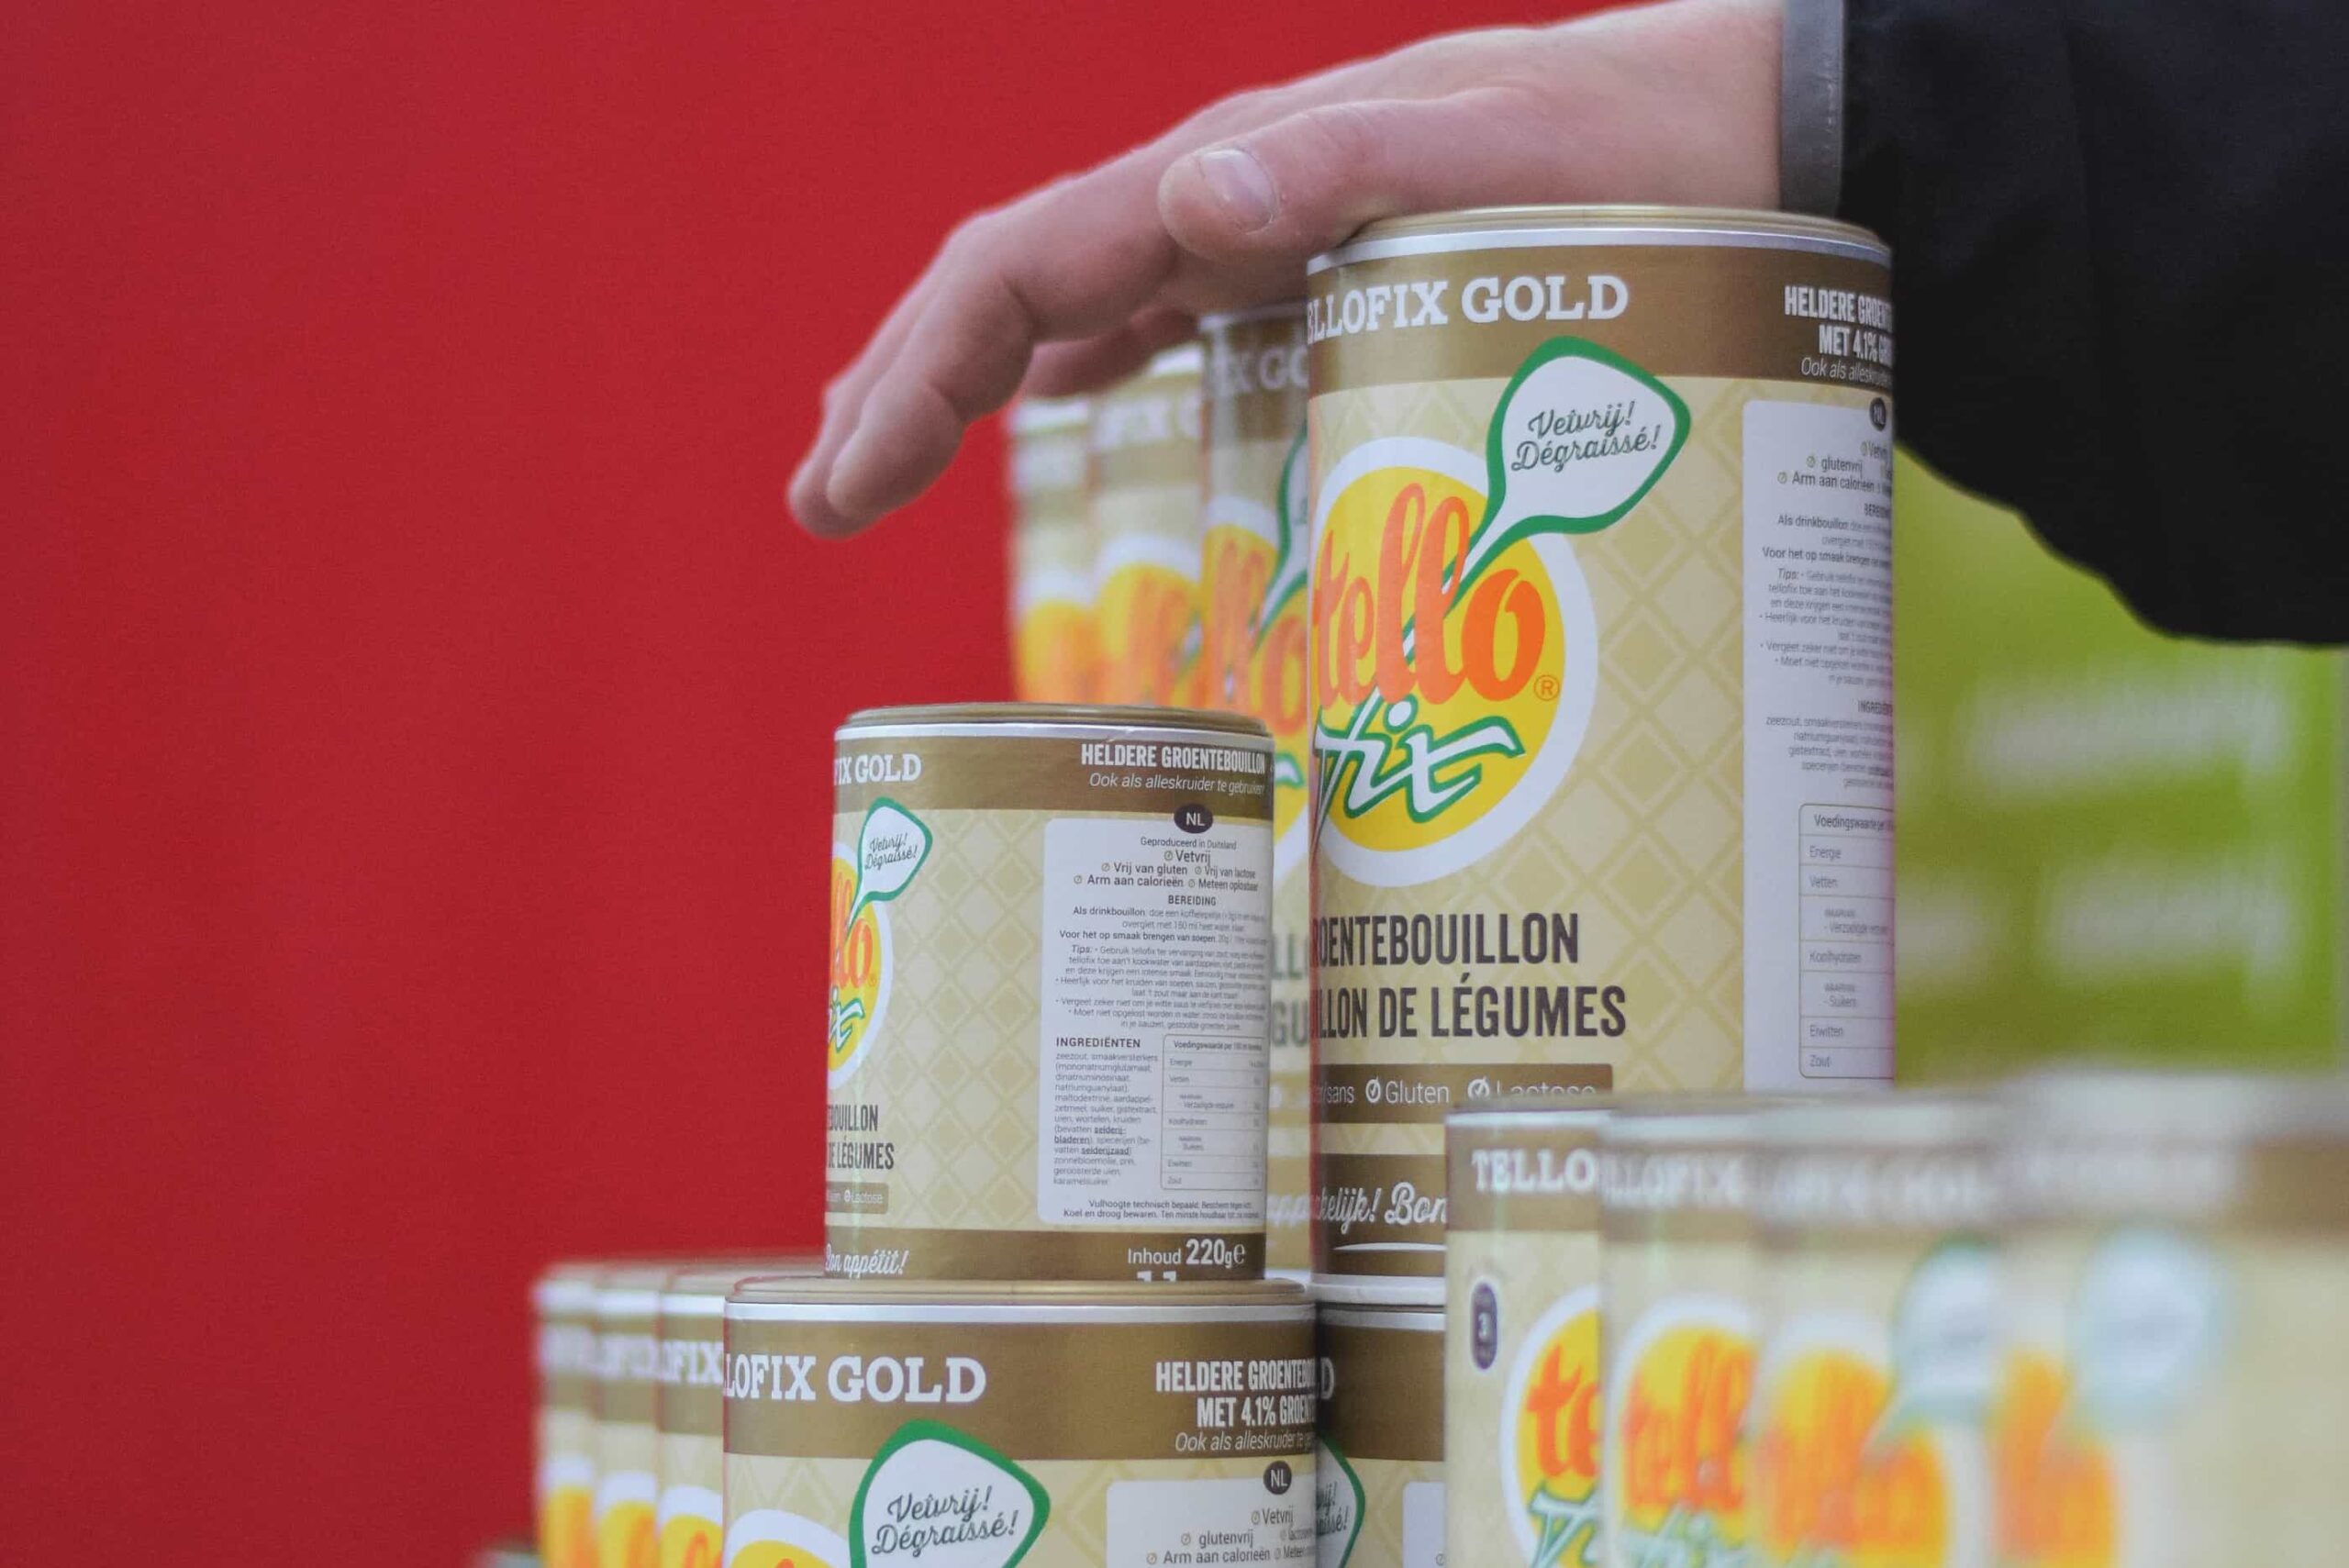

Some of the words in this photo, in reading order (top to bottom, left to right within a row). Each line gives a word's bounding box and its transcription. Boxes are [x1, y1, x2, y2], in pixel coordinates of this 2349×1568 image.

[1462, 274, 1630, 323] GOLD
[1784, 285, 1855, 323] HELDERE
[1819, 325, 1851, 357] MET
[1853, 330, 1877, 362] 4.1%
[1801, 356, 1828, 377] Ook
[1829, 360, 1847, 380] als
[1527, 401, 1636, 440] Vetvrij!
[1511, 425, 1662, 473] Dégraissé!
[1791, 471, 1816, 486] Arm
[1819, 473, 1838, 488] aan
[1778, 515, 1793, 528] Als
[1762, 546, 1786, 559] Voor
[1787, 548, 1803, 561] het
[1805, 550, 1818, 563] op
[854, 752, 922, 784] GOLD
[1081, 743, 1157, 768] HELDERE
[1161, 745, 1266, 774] GROENTEBOUILLON
[1089, 772, 1118, 787] Ook
[1120, 773, 1142, 788] als
[1145, 773, 1216, 793] alleskruider
[1217, 779, 1228, 793] te
[1186, 812, 1206, 827] NL
[1140, 836, 1197, 851] Geproduceerd
[1198, 839, 1206, 849] in
[863, 844, 918, 871] Dégraissé!
[1174, 850, 1211, 868] Vetvrij
[1113, 862, 1132, 876] Vrij
[1135, 864, 1155, 873] van
[1156, 862, 1188, 877] gluten
[1204, 865, 1219, 878] Vrij
[1220, 867, 1234, 877] van
[1086, 874, 1111, 885] Arm
[1113, 876, 1134, 886] aan
[1137, 874, 1185, 888] calorieën
[1197, 879, 1229, 891] Meteen
[1073, 906, 1087, 916] Als
[1167, 894, 1217, 906] BEREIDING
[1059, 929, 1081, 940] Voor
[1082, 929, 1097, 940] het
[1099, 931, 1111, 941] op
[1112, 931, 1141, 940] smaak
[1142, 932, 1176, 943] brengen
[1176, 935, 1191, 943] van
[1378, 986, 1418, 1039] DE
[1431, 972, 1626, 1039] LÉGUMES
[1055, 1035, 1141, 1048] INGREDIËNTEN
[1385, 1078, 1450, 1104] Gluten
[836, 1135, 896, 1171] LÉGUMES
[1063, 1208, 1083, 1218] Koel
[1084, 1209, 1096, 1218] en
[1097, 1208, 1122, 1220] droog
[1161, 1209, 1174, 1219] Ten
[1088, 1199, 1132, 1209] Vulhoogte
[1132, 1199, 1170, 1209] technisch
[842, 1249, 909, 1279] appétit!
[1127, 1247, 1182, 1265] Inhoud
[827, 1355, 987, 1404] GOLD
[1155, 1360, 1244, 1393] HELDERE
[1197, 1396, 1237, 1429] MET
[1241, 1395, 1276, 1428] 4.1%
[1174, 1431, 1207, 1452] Ook
[1209, 1432, 1231, 1451] als
[1234, 1429, 1297, 1451] alleskruider
[1270, 1469, 1288, 1487] NL
[886, 1485, 993, 1524] Vetvrij!
[1262, 1506, 1294, 1526] Vetvrij
[871, 1509, 1019, 1559] Dégraissé!
[1197, 1529, 1254, 1551] glutenvrij
[1163, 1550, 1192, 1565] Arm
[1196, 1551, 1219, 1564] aan
[1221, 1547, 1271, 1564] calorieën
